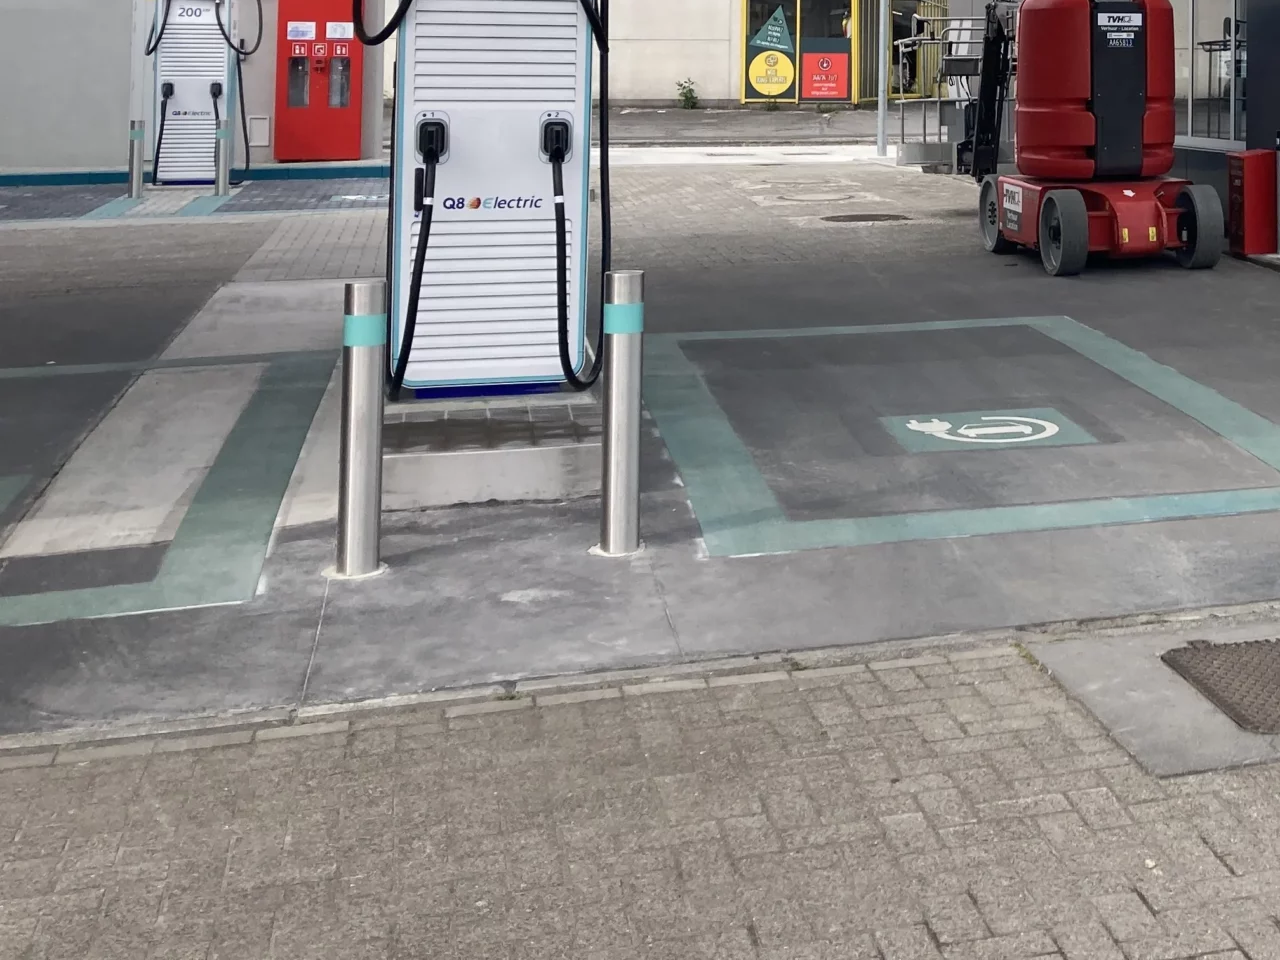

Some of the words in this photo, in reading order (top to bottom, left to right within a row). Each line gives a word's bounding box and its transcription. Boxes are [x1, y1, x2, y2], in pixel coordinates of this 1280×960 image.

[178, 7, 202, 18] 200
[1107, 15, 1125, 24] TVH
[443, 197, 465, 210] Q8
[482, 196, 543, 209] Electric
